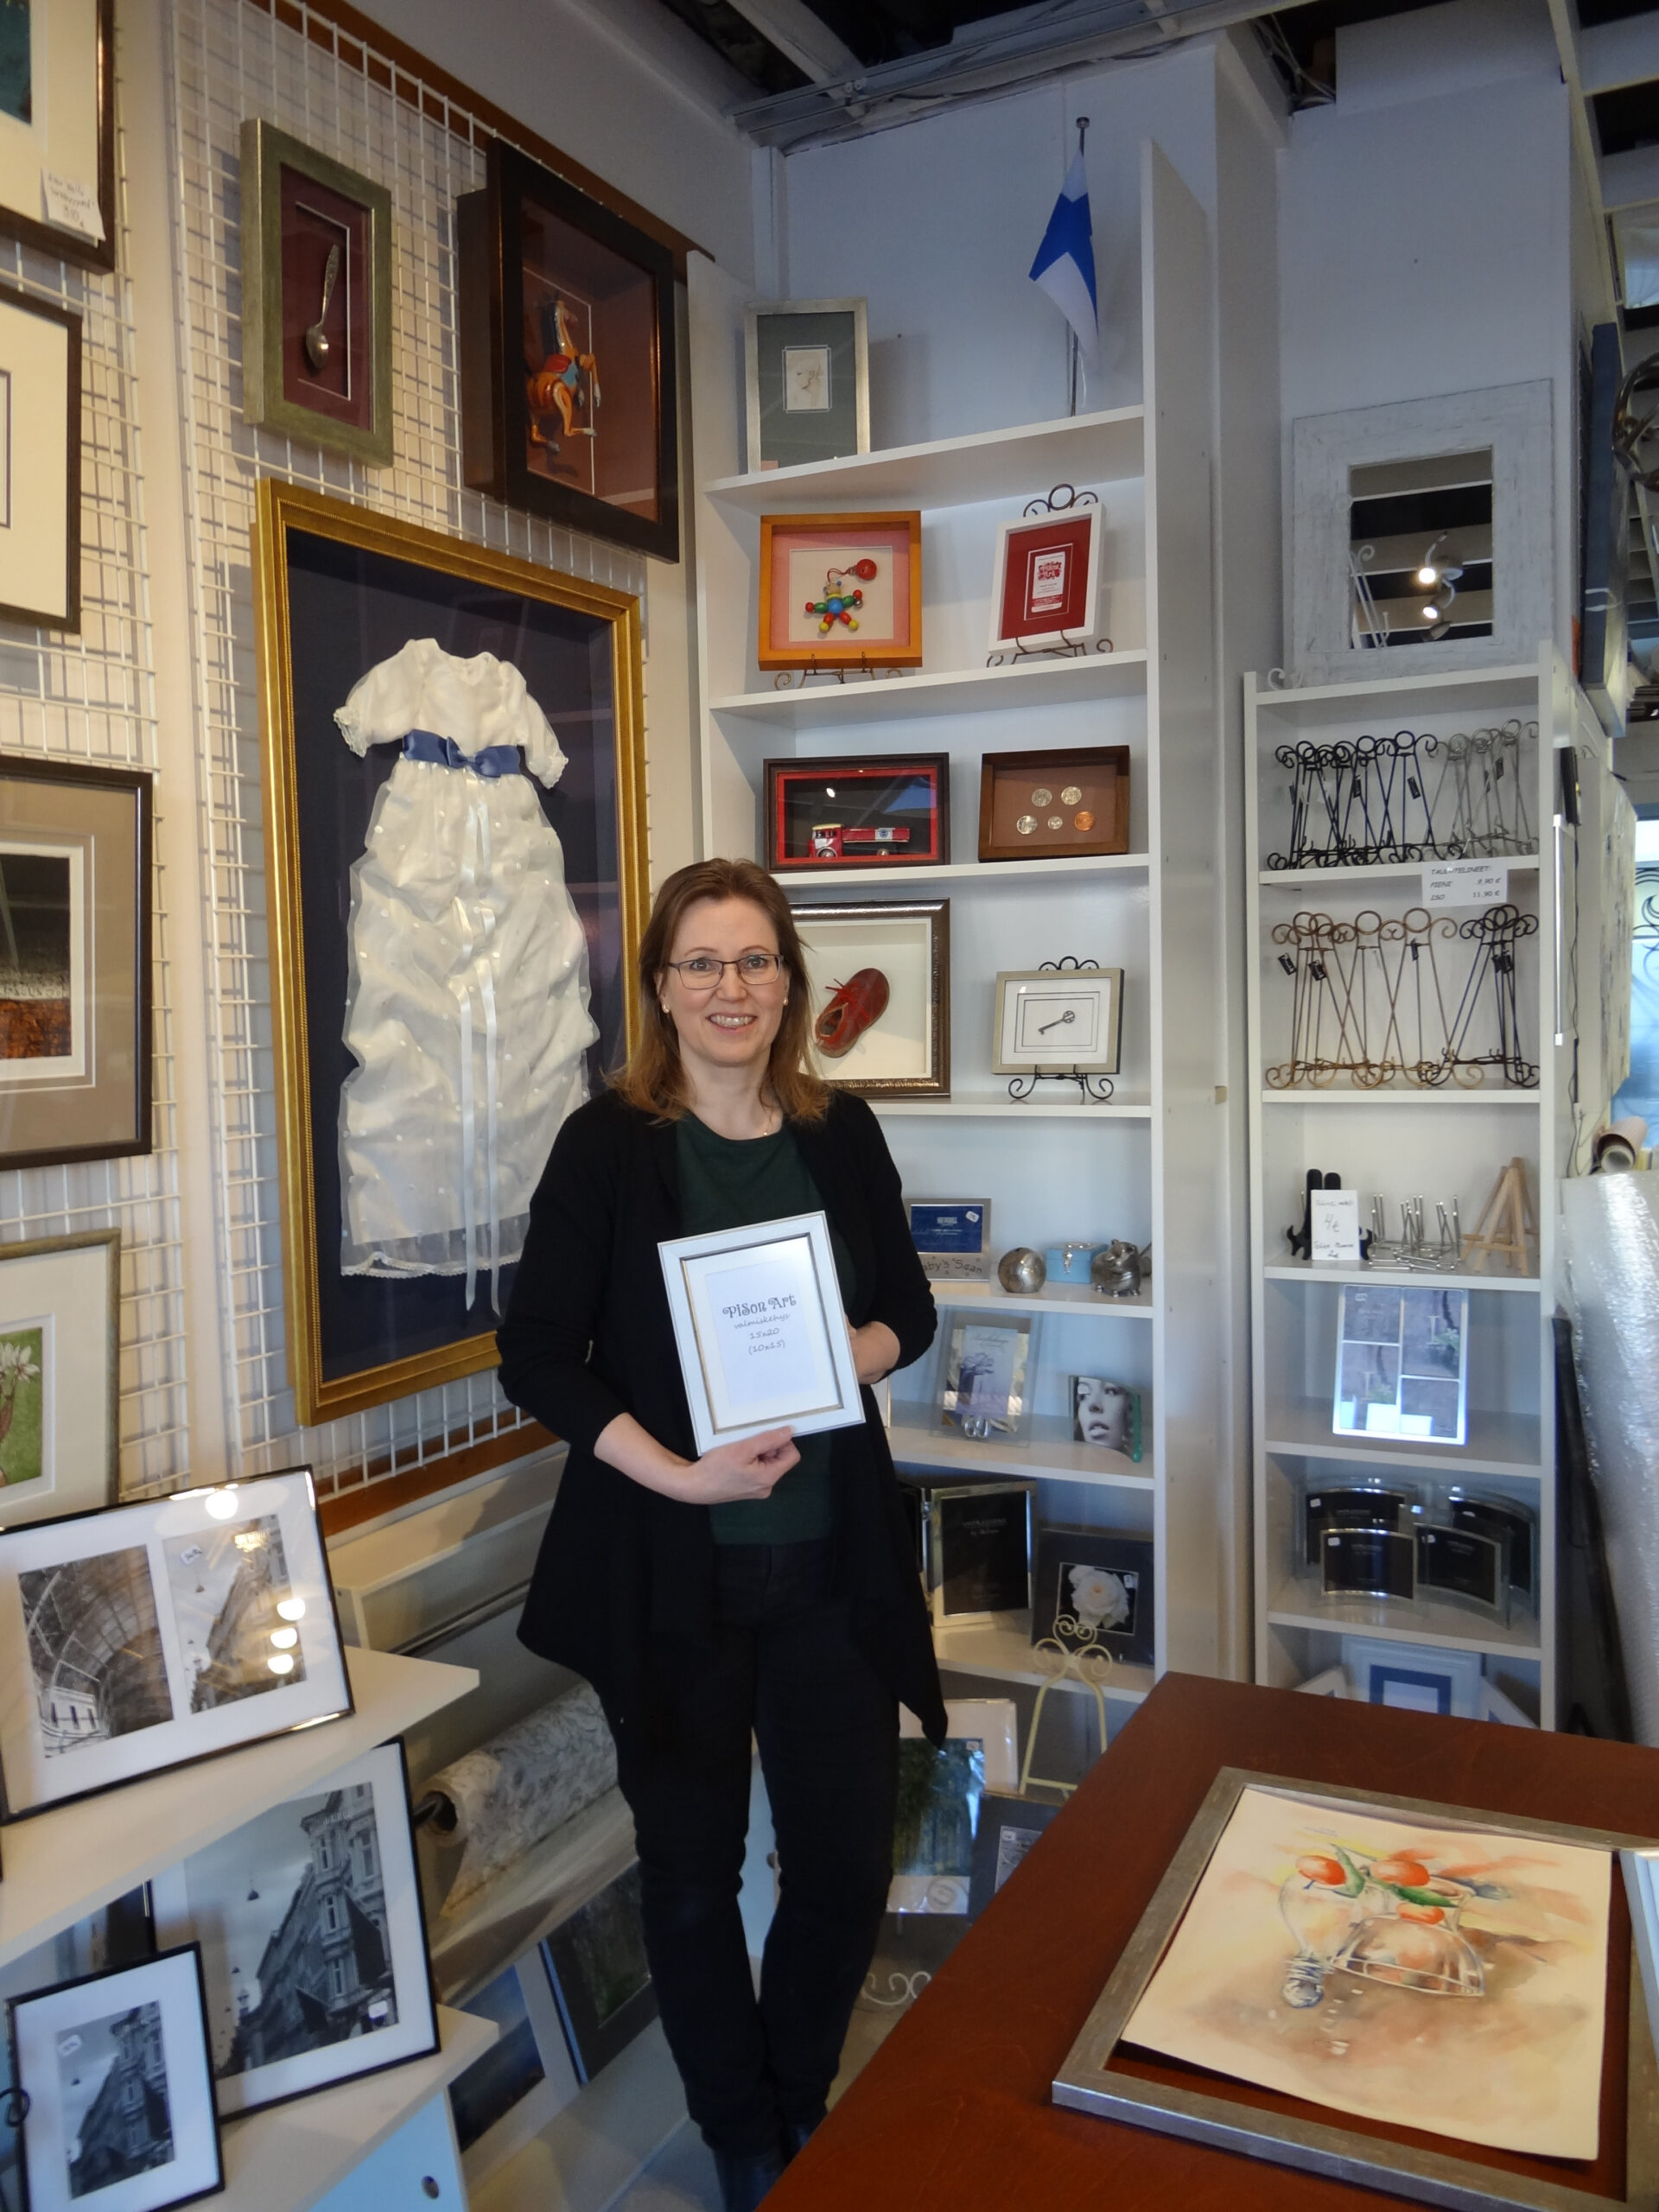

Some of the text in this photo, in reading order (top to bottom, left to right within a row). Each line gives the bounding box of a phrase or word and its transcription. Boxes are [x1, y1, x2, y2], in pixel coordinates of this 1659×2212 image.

[922, 1257, 982, 1274] aby's Scan
[767, 1293, 797, 1310] Art
[734, 1313, 790, 1329] valmiskehys
[749, 1327, 779, 1340] 15x20
[748, 1339, 785, 1356] (10x15)
